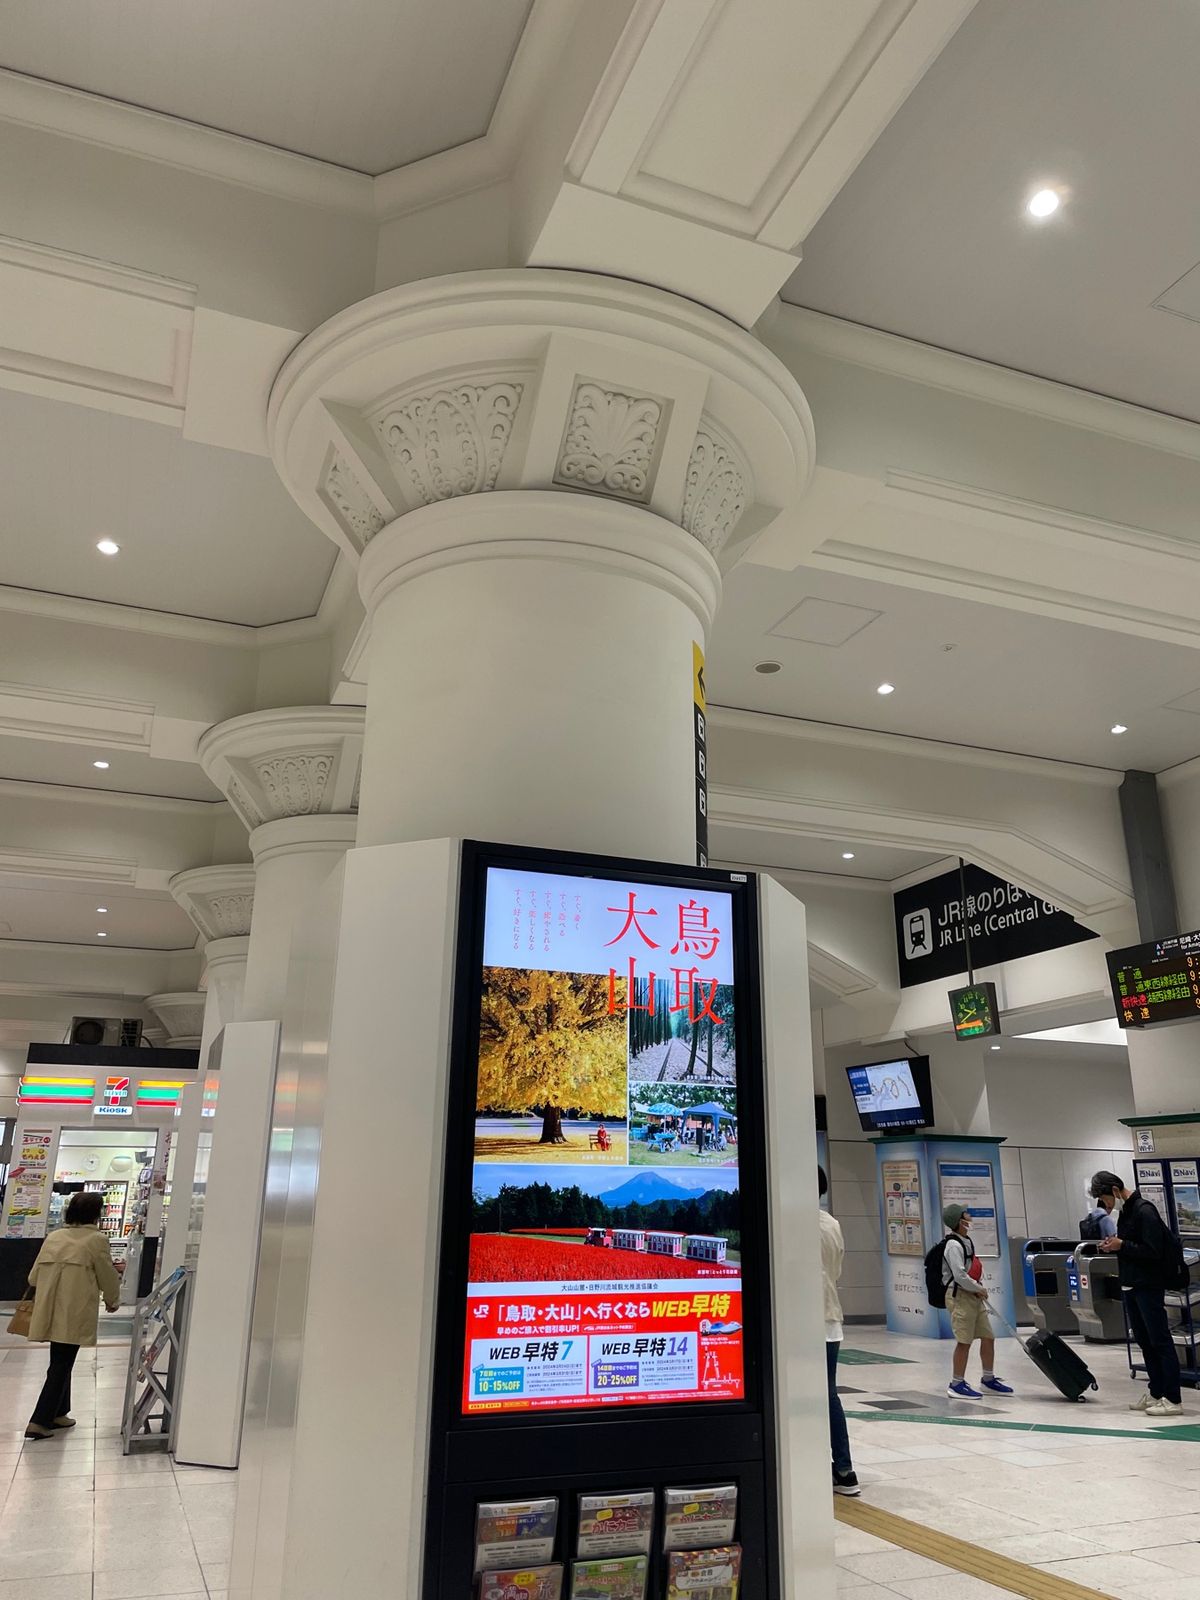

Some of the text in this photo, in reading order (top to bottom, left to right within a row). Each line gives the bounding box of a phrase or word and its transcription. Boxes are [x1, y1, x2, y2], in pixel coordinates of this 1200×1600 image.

[939, 928, 953, 948] JR
[955, 923, 981, 942] Line
[984, 900, 1039, 936] (Central
[99, 1106, 128, 1114] Kiosk
[489, 1340, 574, 1362] WEB 早特 7
[601, 1342, 631, 1356] WEB
[632, 1337, 667, 1358] 早特
[667, 1336, 689, 1356] 14
